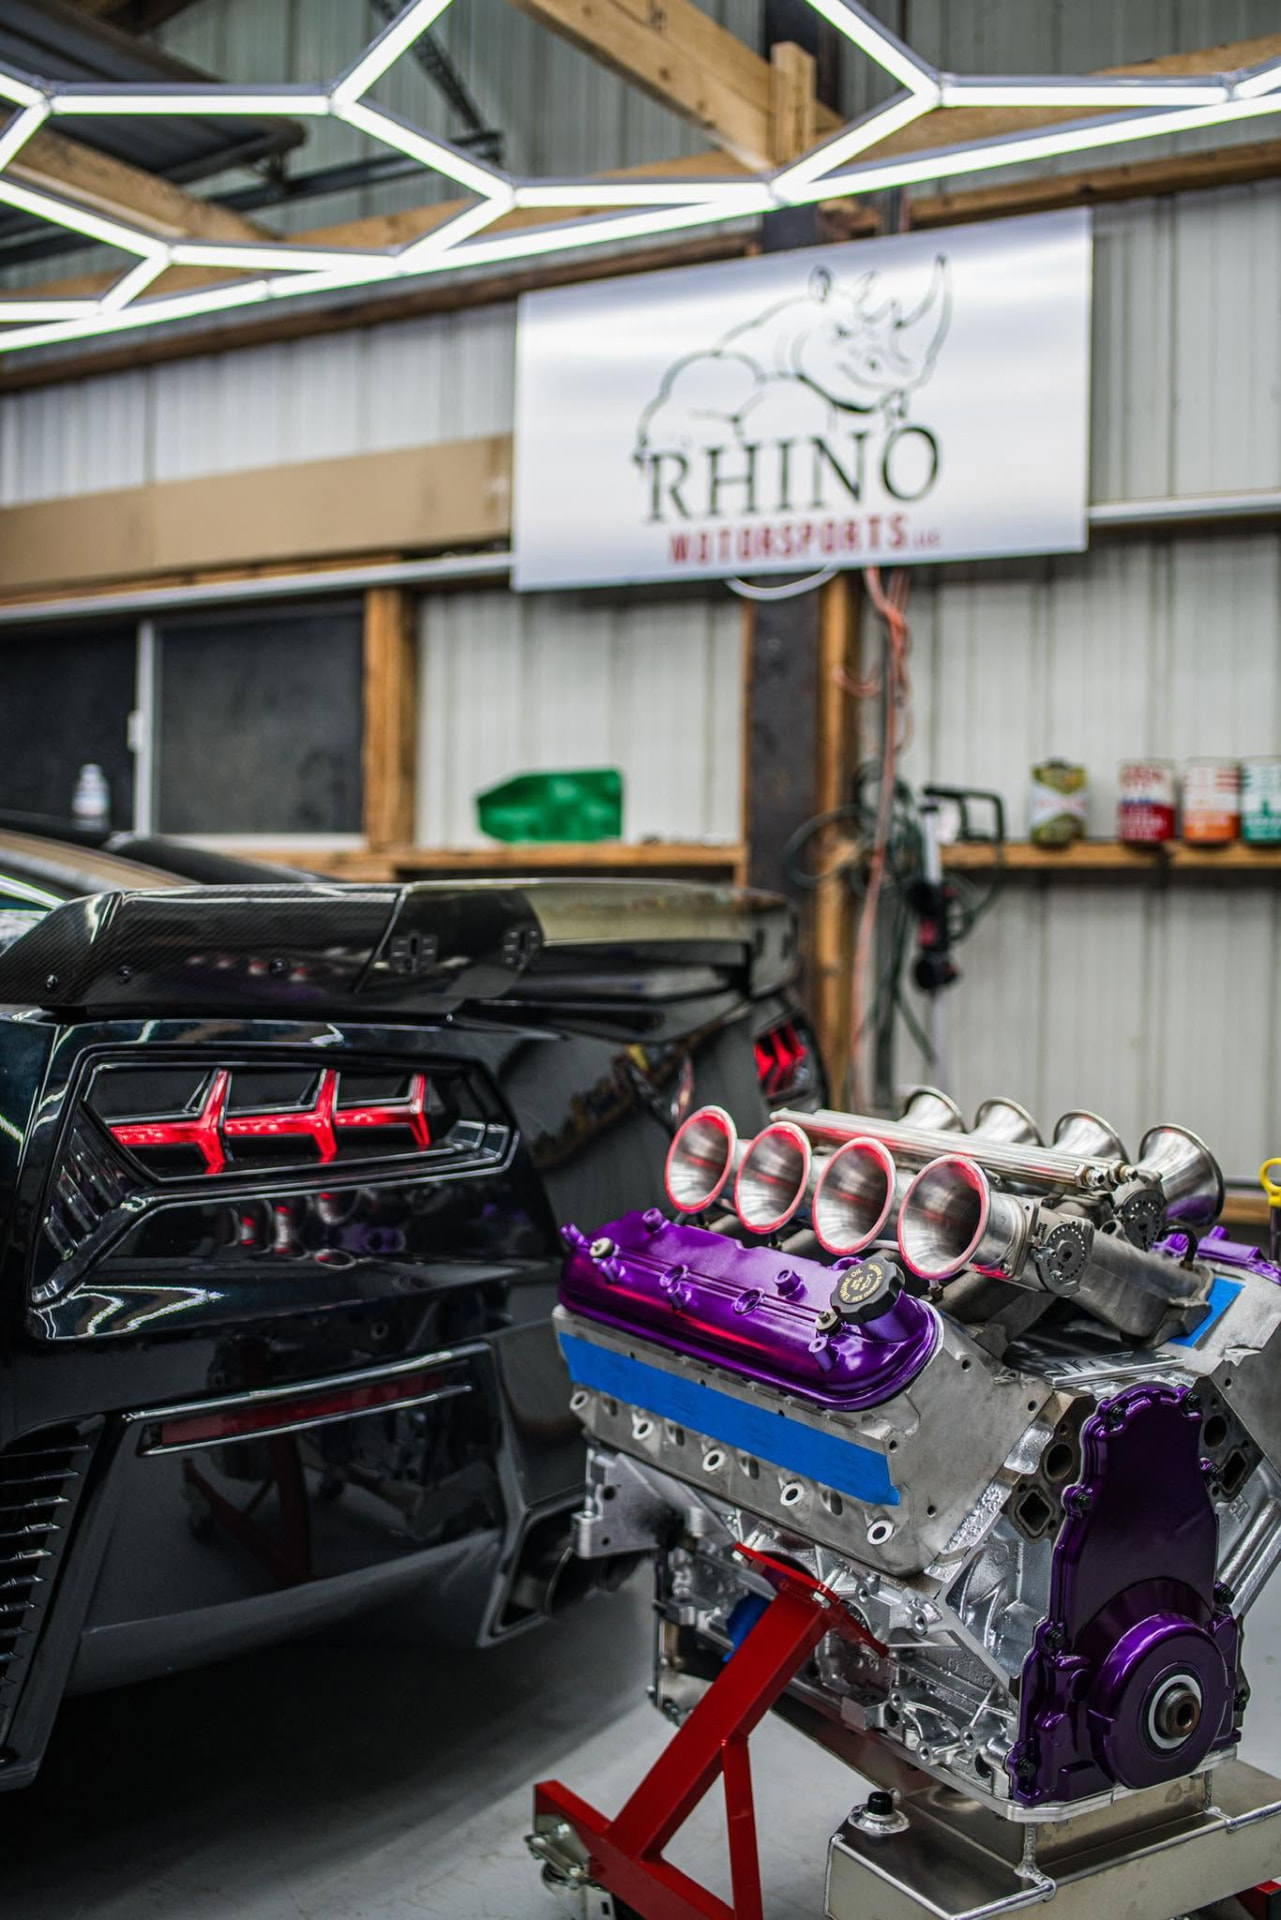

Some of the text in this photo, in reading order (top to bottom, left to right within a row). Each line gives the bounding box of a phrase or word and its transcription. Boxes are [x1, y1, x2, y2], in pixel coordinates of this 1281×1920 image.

[648, 426, 939, 522] RHINO
[669, 513, 908, 564] MOTORSPORTS
[851, 1268, 863, 1277] OIL
